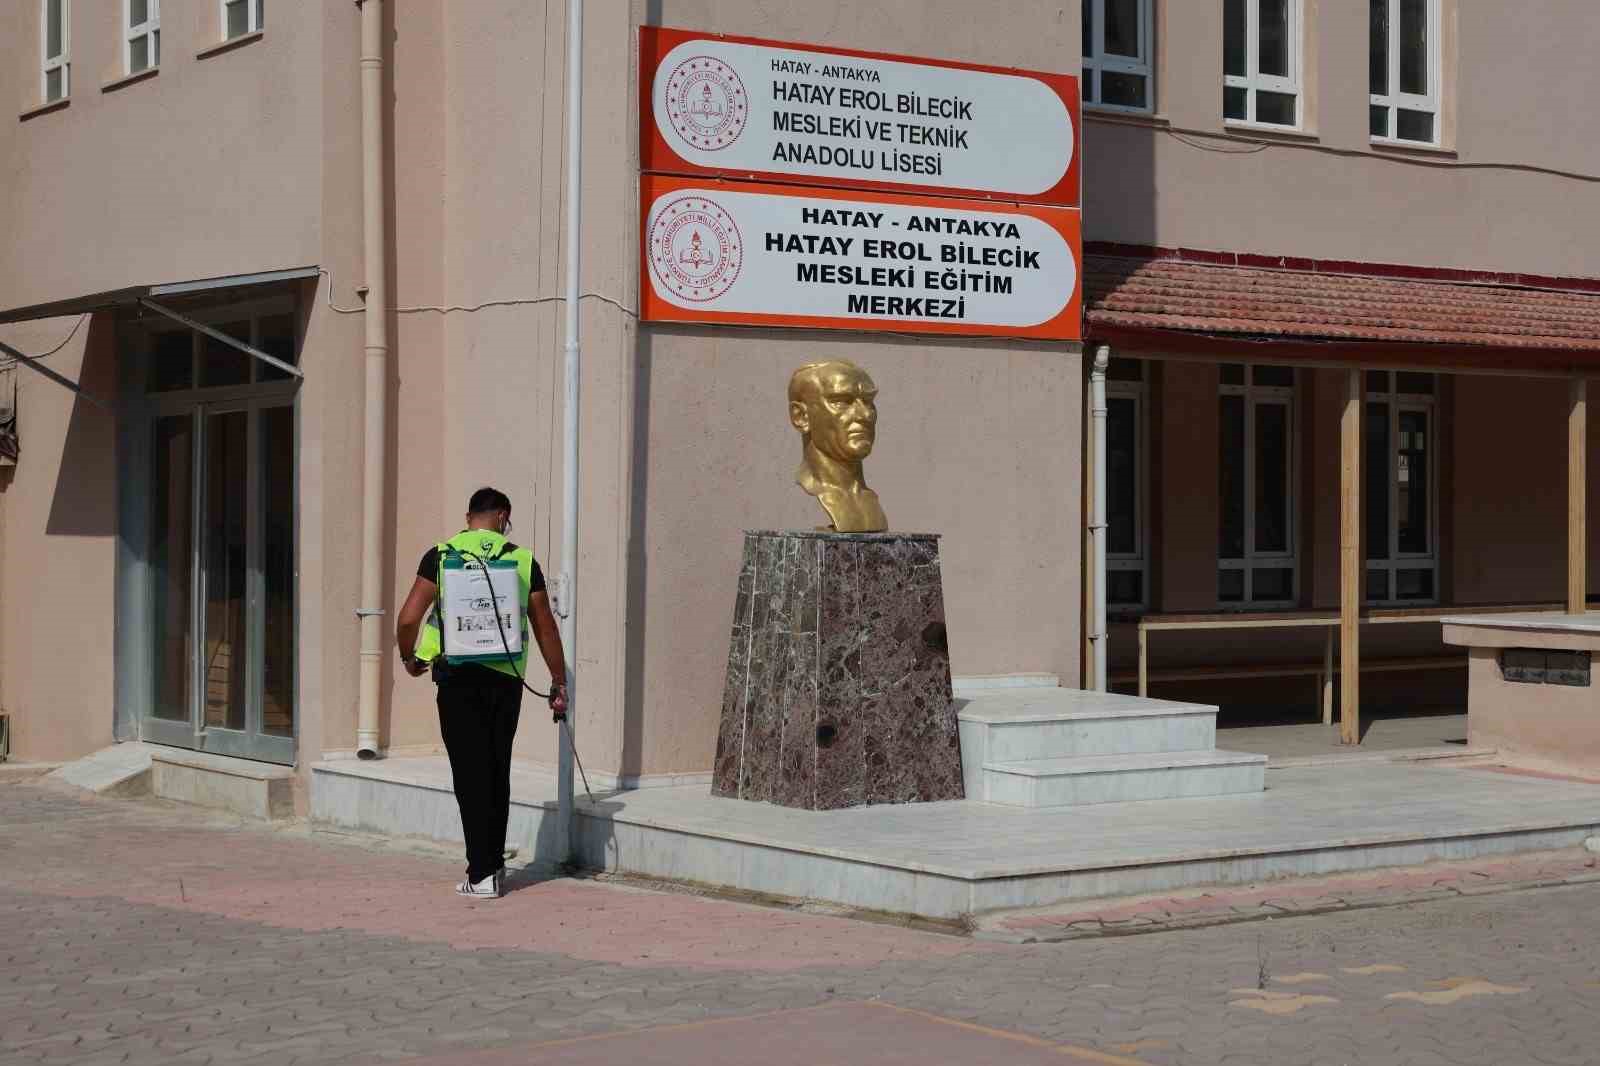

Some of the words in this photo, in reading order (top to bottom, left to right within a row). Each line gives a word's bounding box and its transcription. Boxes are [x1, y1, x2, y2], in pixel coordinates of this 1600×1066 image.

[772, 59, 811, 75] HATAY
[822, 65, 881, 83] ANTAKYA
[773, 80, 835, 106] HATAY
[840, 88, 893, 112] EROL
[897, 91, 973, 121] BİLECİK
[773, 111, 861, 138] MESLEKİ
[865, 121, 892, 141] VE
[896, 124, 969, 150] TEKNİK
[772, 142, 874, 169] ANADOLU
[882, 148, 942, 175] LİSESİ
[802, 208, 884, 228] HATAY
[907, 216, 1020, 239] ANTAKYA
[765, 232, 854, 256] HATAY
[863, 239, 932, 261] EROL
[941, 242, 1040, 270] BİLECİK
[797, 263, 914, 288] MESLEKİ
[924, 268, 1012, 294] EĞİTİM
[848, 294, 965, 319] MERKEZİ
